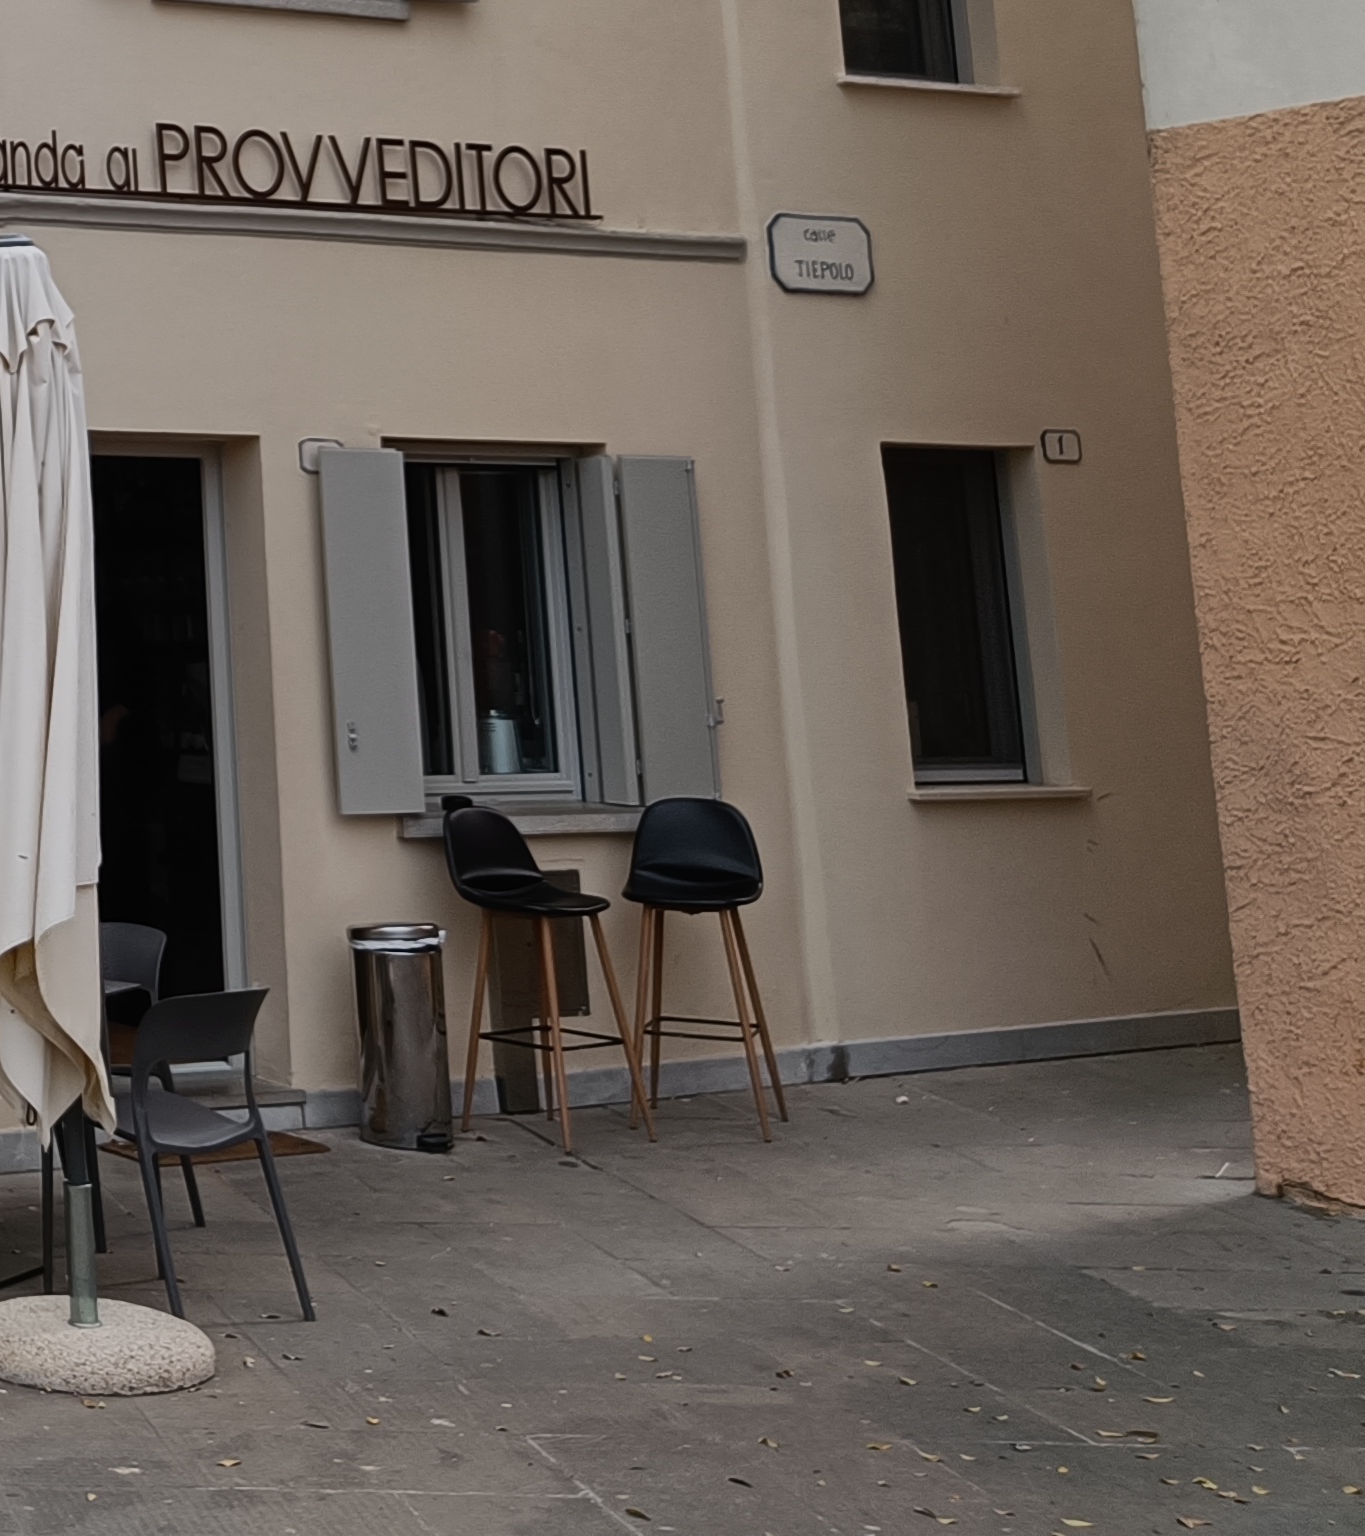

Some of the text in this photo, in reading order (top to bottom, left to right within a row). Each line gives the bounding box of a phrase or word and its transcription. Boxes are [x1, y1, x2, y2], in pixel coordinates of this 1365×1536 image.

[106, 144, 140, 194] ai
[155, 122, 593, 217] PROVVEDITORI
[794, 259, 855, 281] TIEPOLO
[1057, 434, 1064, 455] 1
